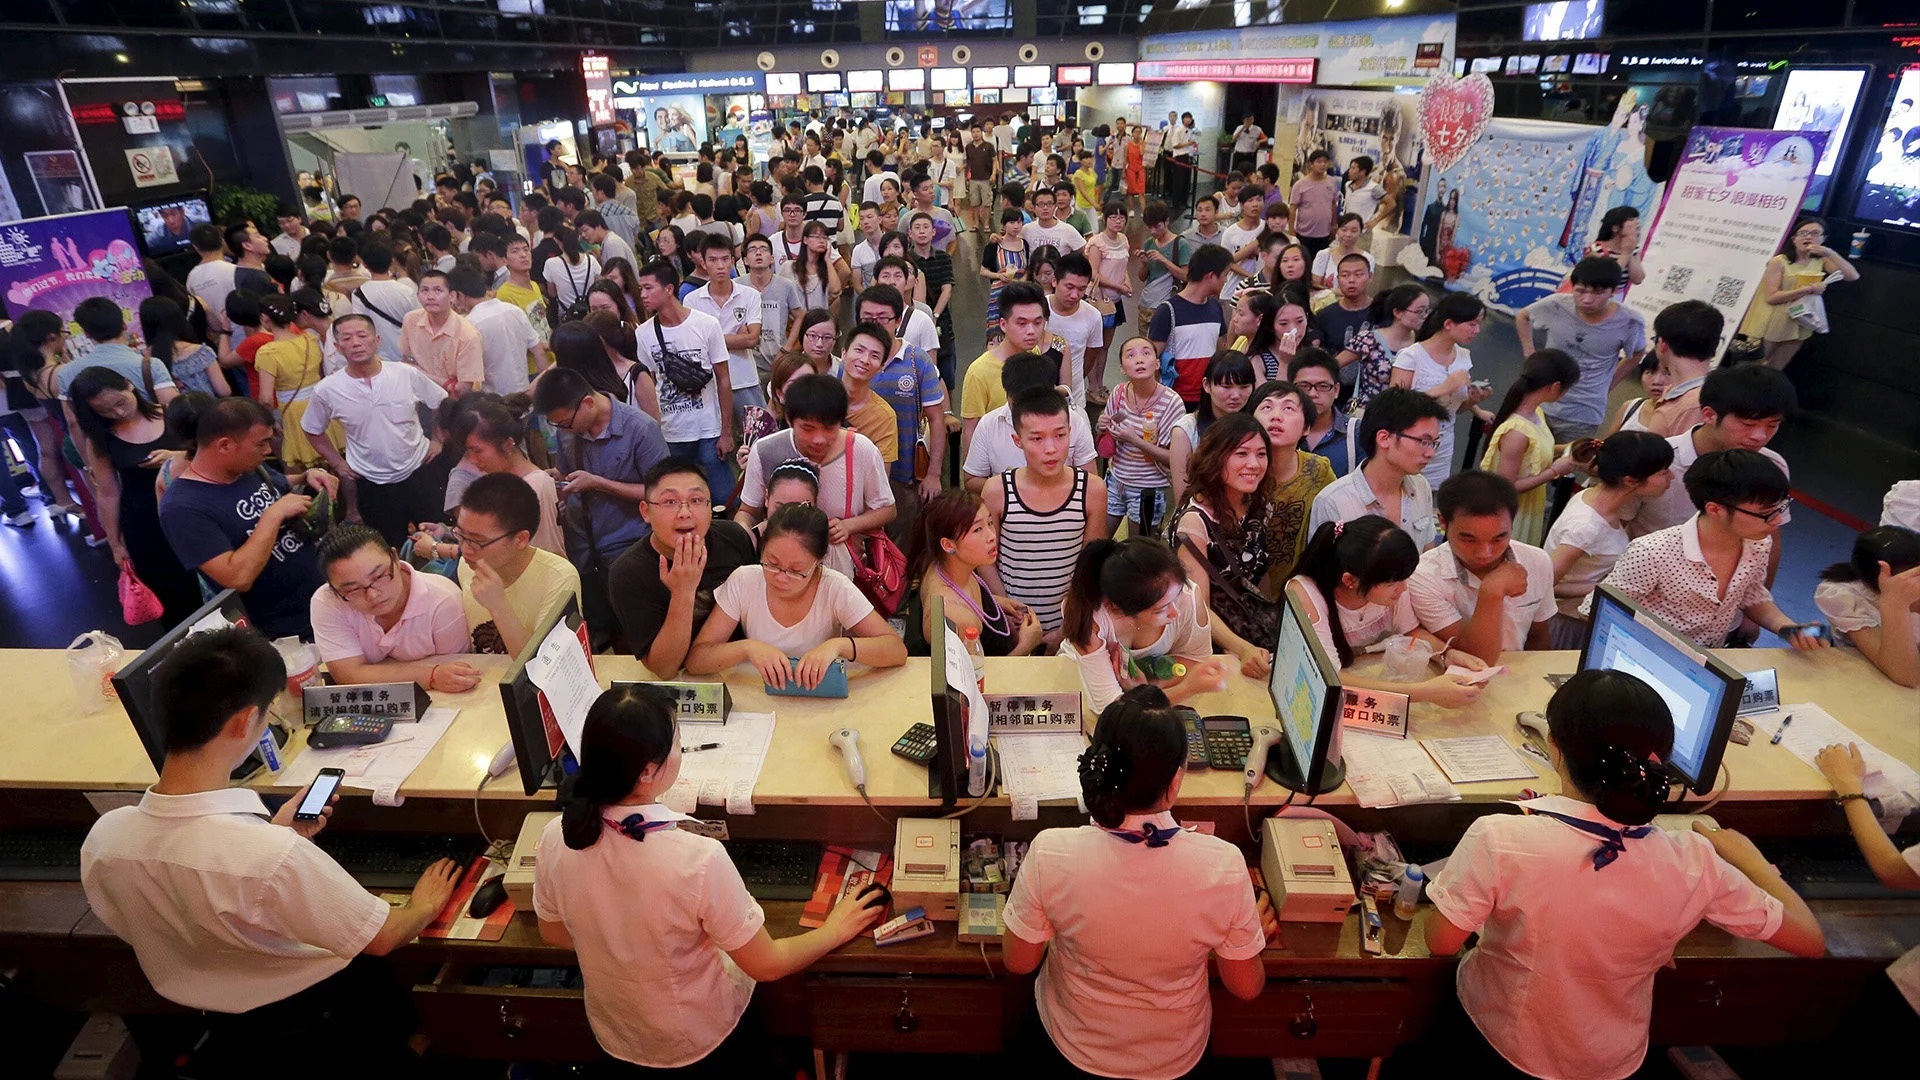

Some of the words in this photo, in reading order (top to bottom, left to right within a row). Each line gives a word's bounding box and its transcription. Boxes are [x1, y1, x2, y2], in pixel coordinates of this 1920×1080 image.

[1437, 123, 1468, 148] 七夕
[1680, 184, 1788, 212] 甜蜜七夕浪漫相约
[330, 690, 390, 704] 暂停服务
[1345, 693, 1377, 709] 服务
[1743, 690, 1774, 704] 口购票
[310, 702, 411, 717] 请到相邻窗口购票
[989, 700, 1053, 712] 暂停服务
[1343, 707, 1401, 726] 窗口购票
